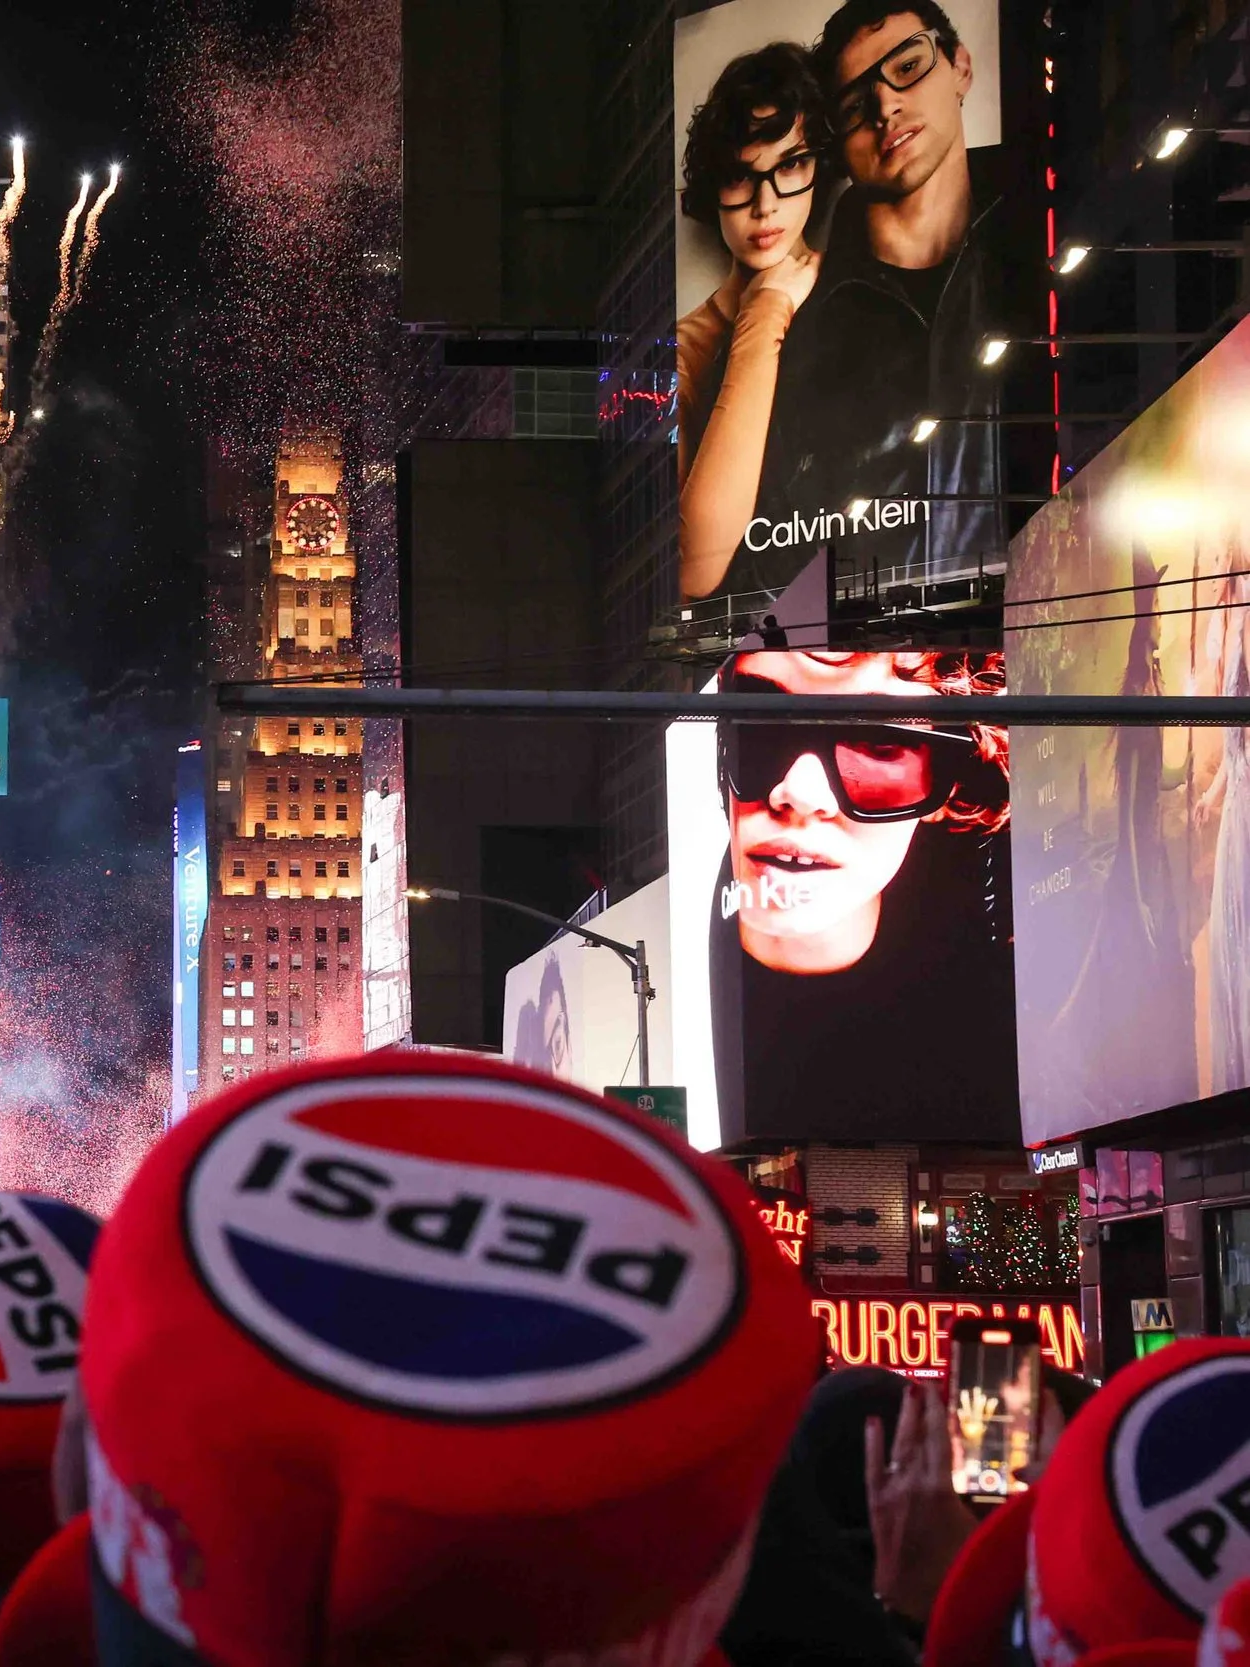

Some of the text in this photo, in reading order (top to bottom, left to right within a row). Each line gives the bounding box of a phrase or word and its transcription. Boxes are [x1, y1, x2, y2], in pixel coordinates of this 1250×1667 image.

[744, 493, 931, 552] Calvin Klein
[1037, 735, 1055, 761] YOU
[1038, 780, 1057, 807] WILL
[1043, 828, 1054, 852] BE
[1029, 866, 1072, 906] CHANGED
[184, 845, 200, 973] Venture X
[639, 1098, 653, 1109] 9A
[237, 1139, 693, 1314] PEPSI
[811, 1300, 981, 1367] BURGE
